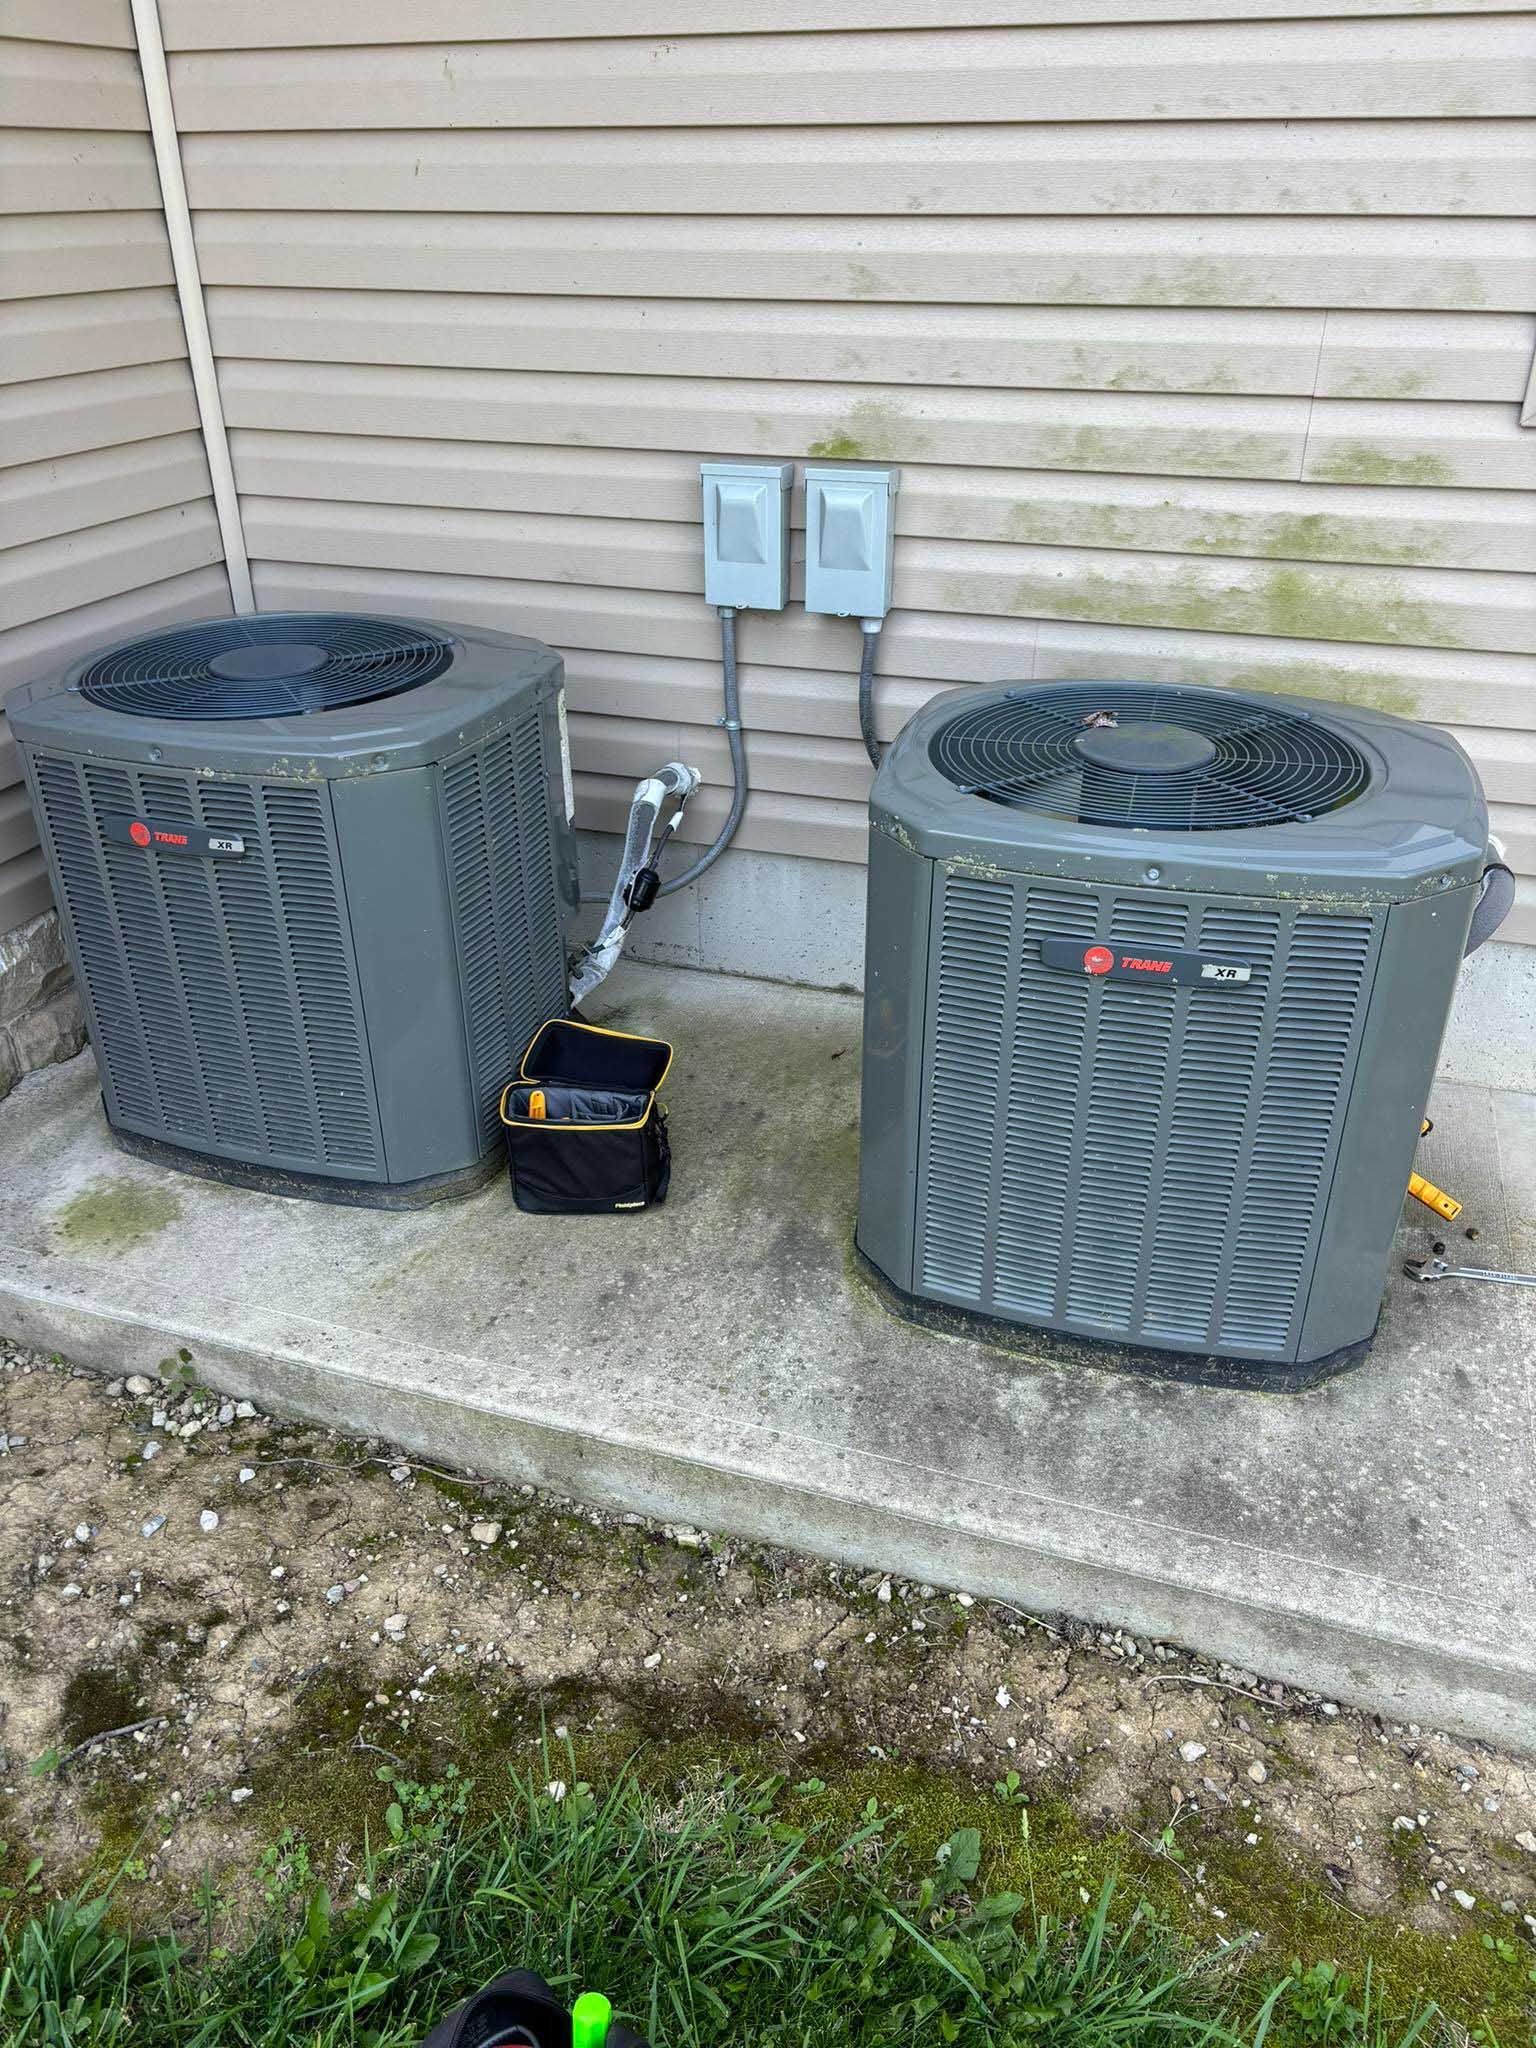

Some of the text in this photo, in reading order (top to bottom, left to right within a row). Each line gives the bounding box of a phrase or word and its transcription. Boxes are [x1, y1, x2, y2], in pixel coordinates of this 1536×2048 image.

[153, 831, 233, 850] TRANE XR
[1121, 957, 1237, 979] TRANE XR
